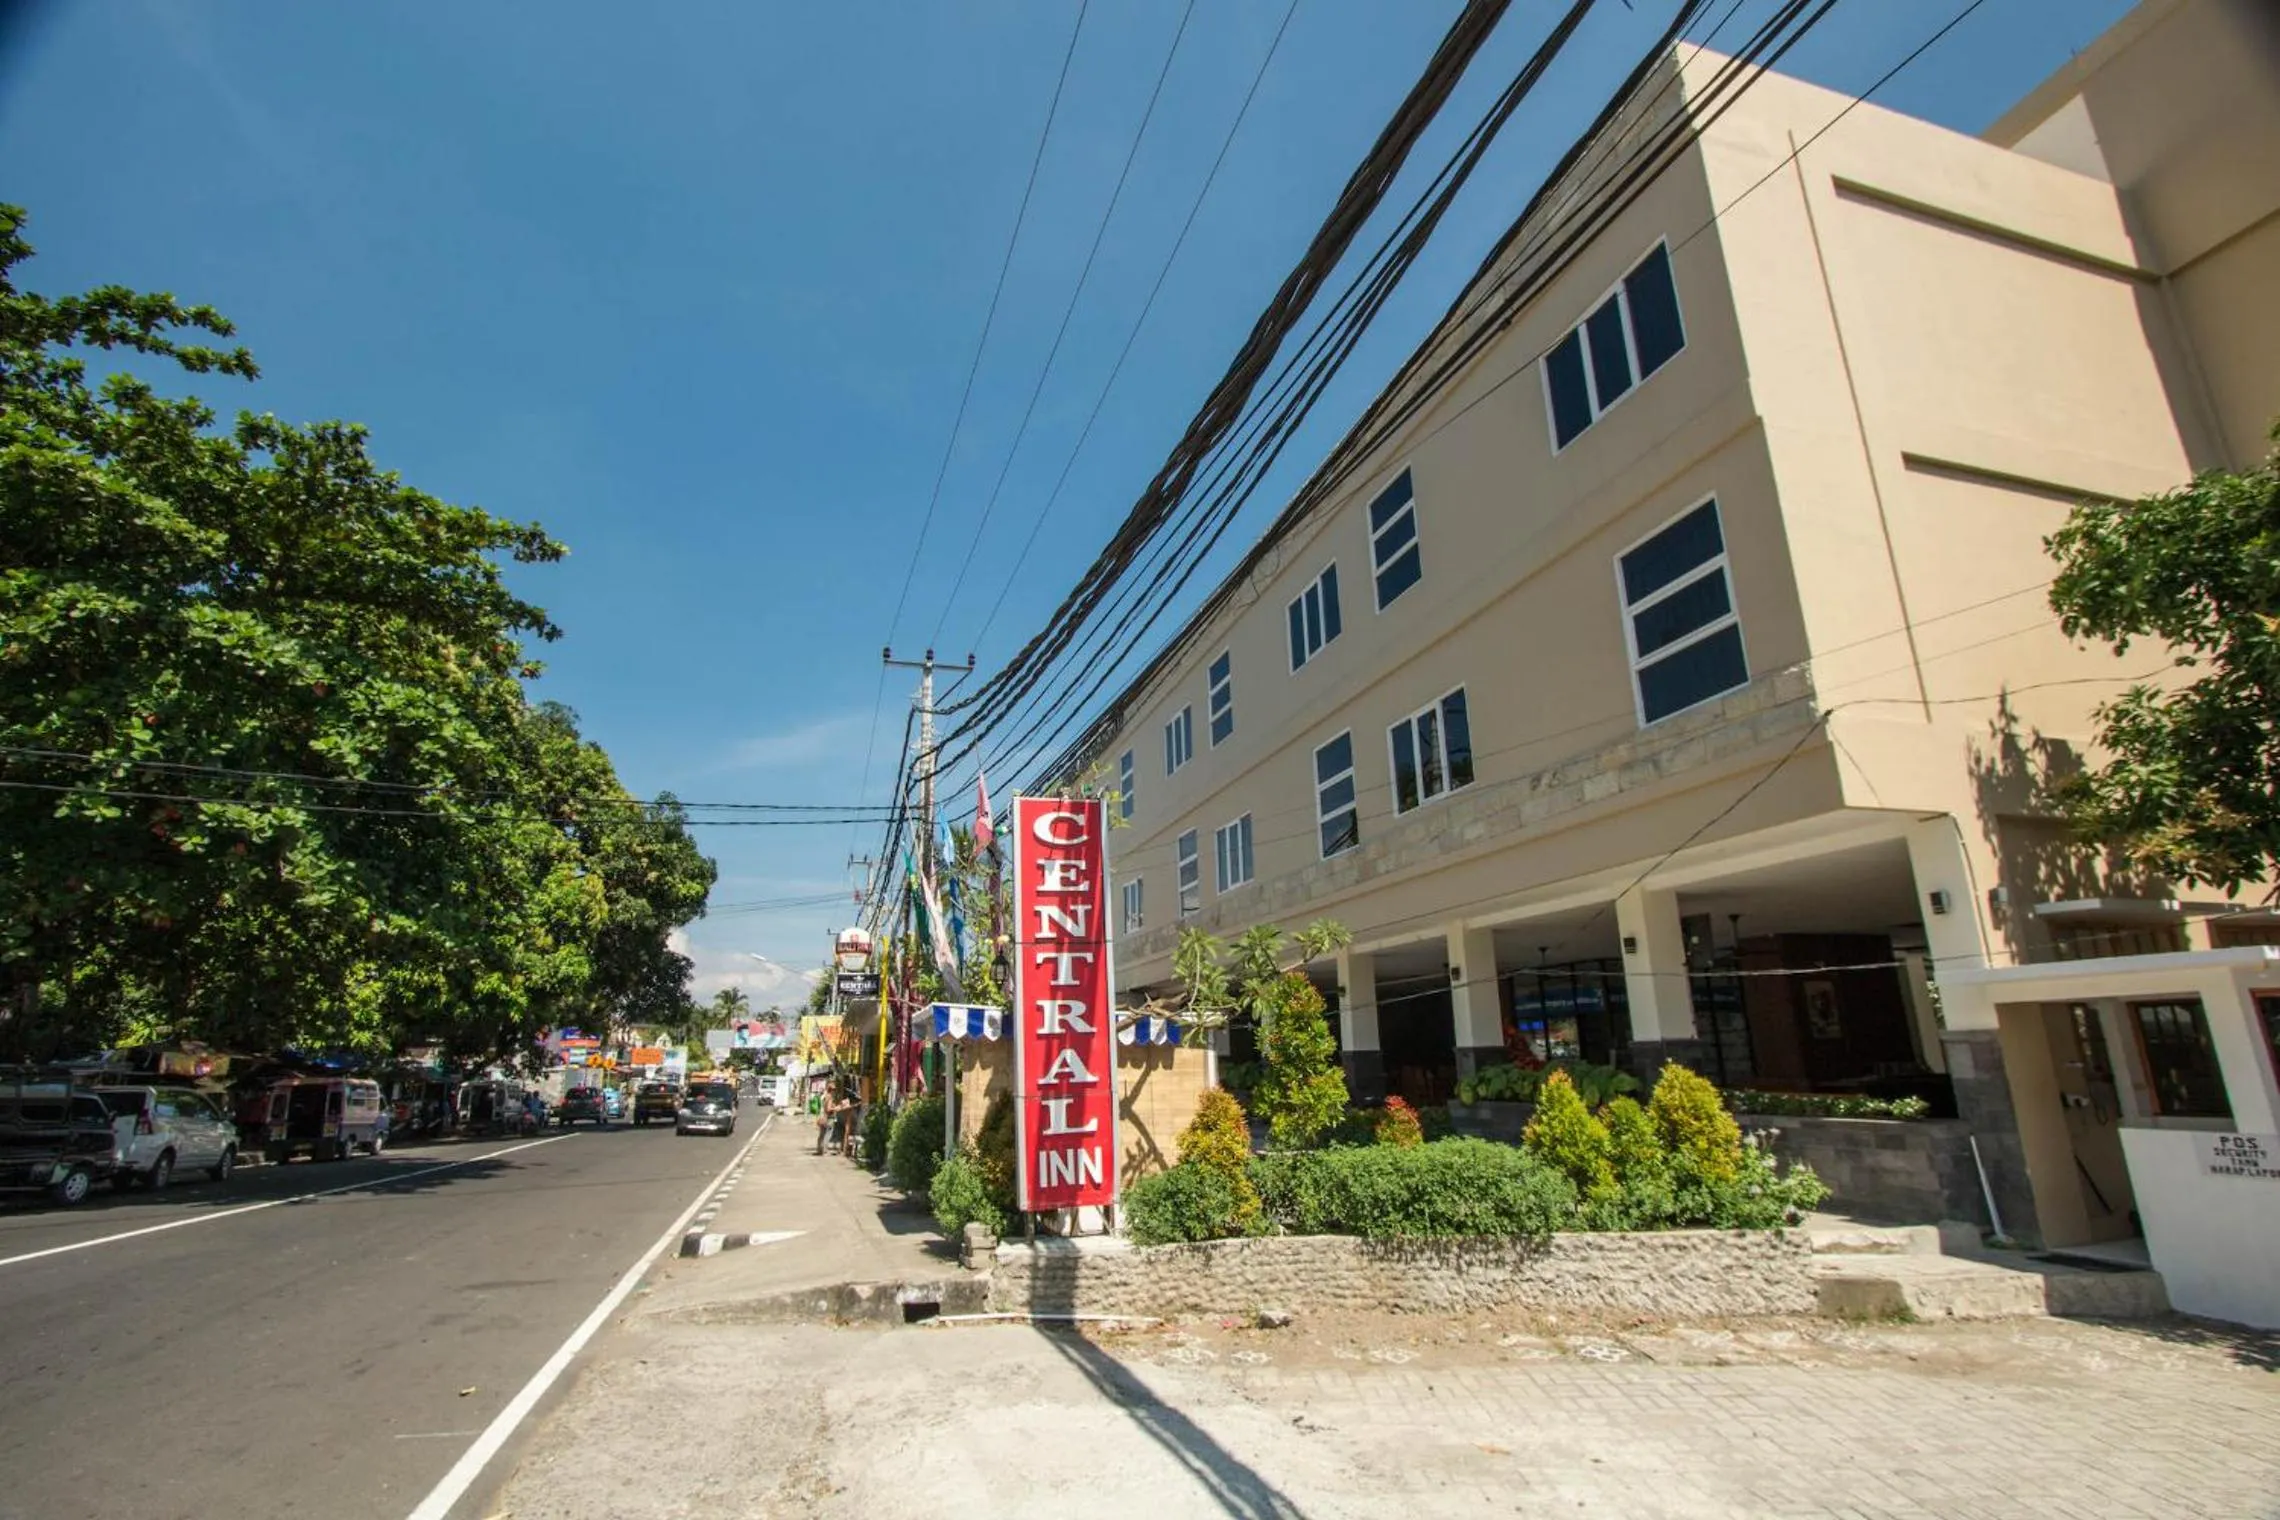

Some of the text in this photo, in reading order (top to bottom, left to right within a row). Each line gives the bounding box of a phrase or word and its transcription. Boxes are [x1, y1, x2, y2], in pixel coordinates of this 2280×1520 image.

[1033, 812, 1099, 1136] CENTRAL
[2213, 1147, 2267, 1159] SECURITY
[2220, 1136, 2257, 1148] POS
[1039, 1146, 1104, 1189] INN
